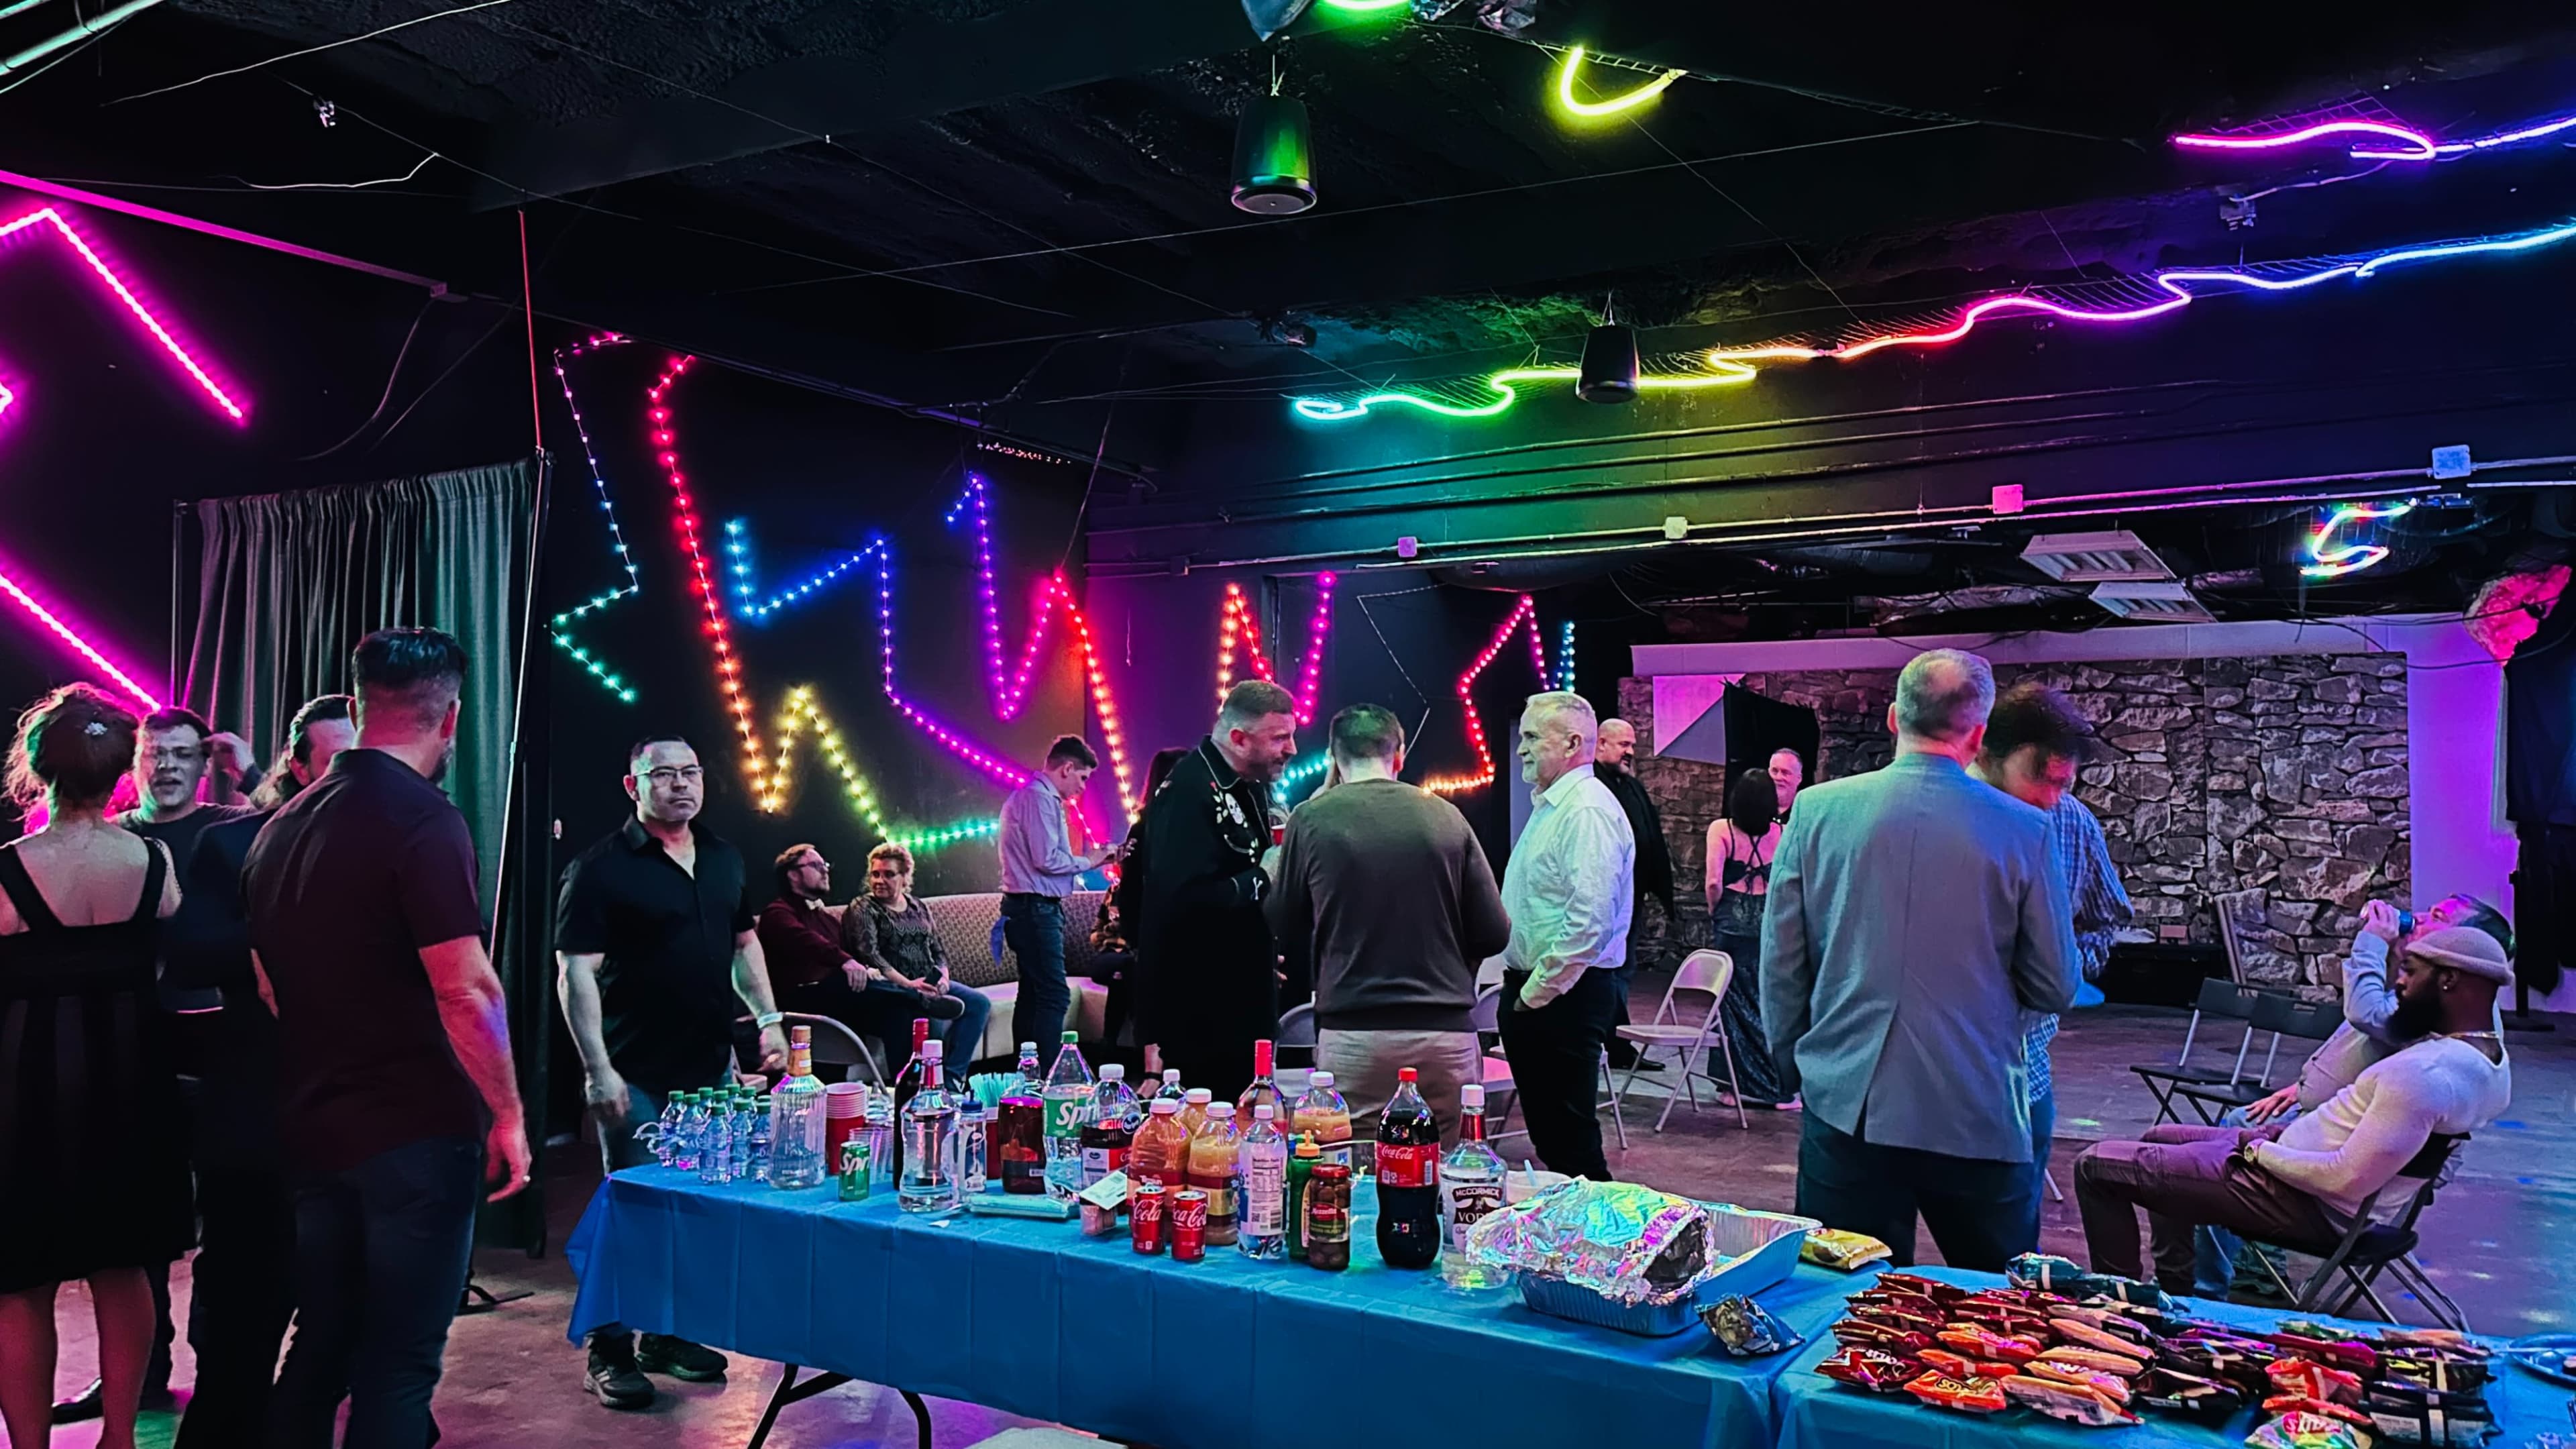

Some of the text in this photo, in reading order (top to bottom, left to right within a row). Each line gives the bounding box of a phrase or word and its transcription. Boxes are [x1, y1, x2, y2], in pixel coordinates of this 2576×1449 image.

[1056, 1102, 1100, 1130] Spri
[1382, 1145, 1413, 1159] Coca-Cola
[1458, 1212, 1484, 1223] VOD
